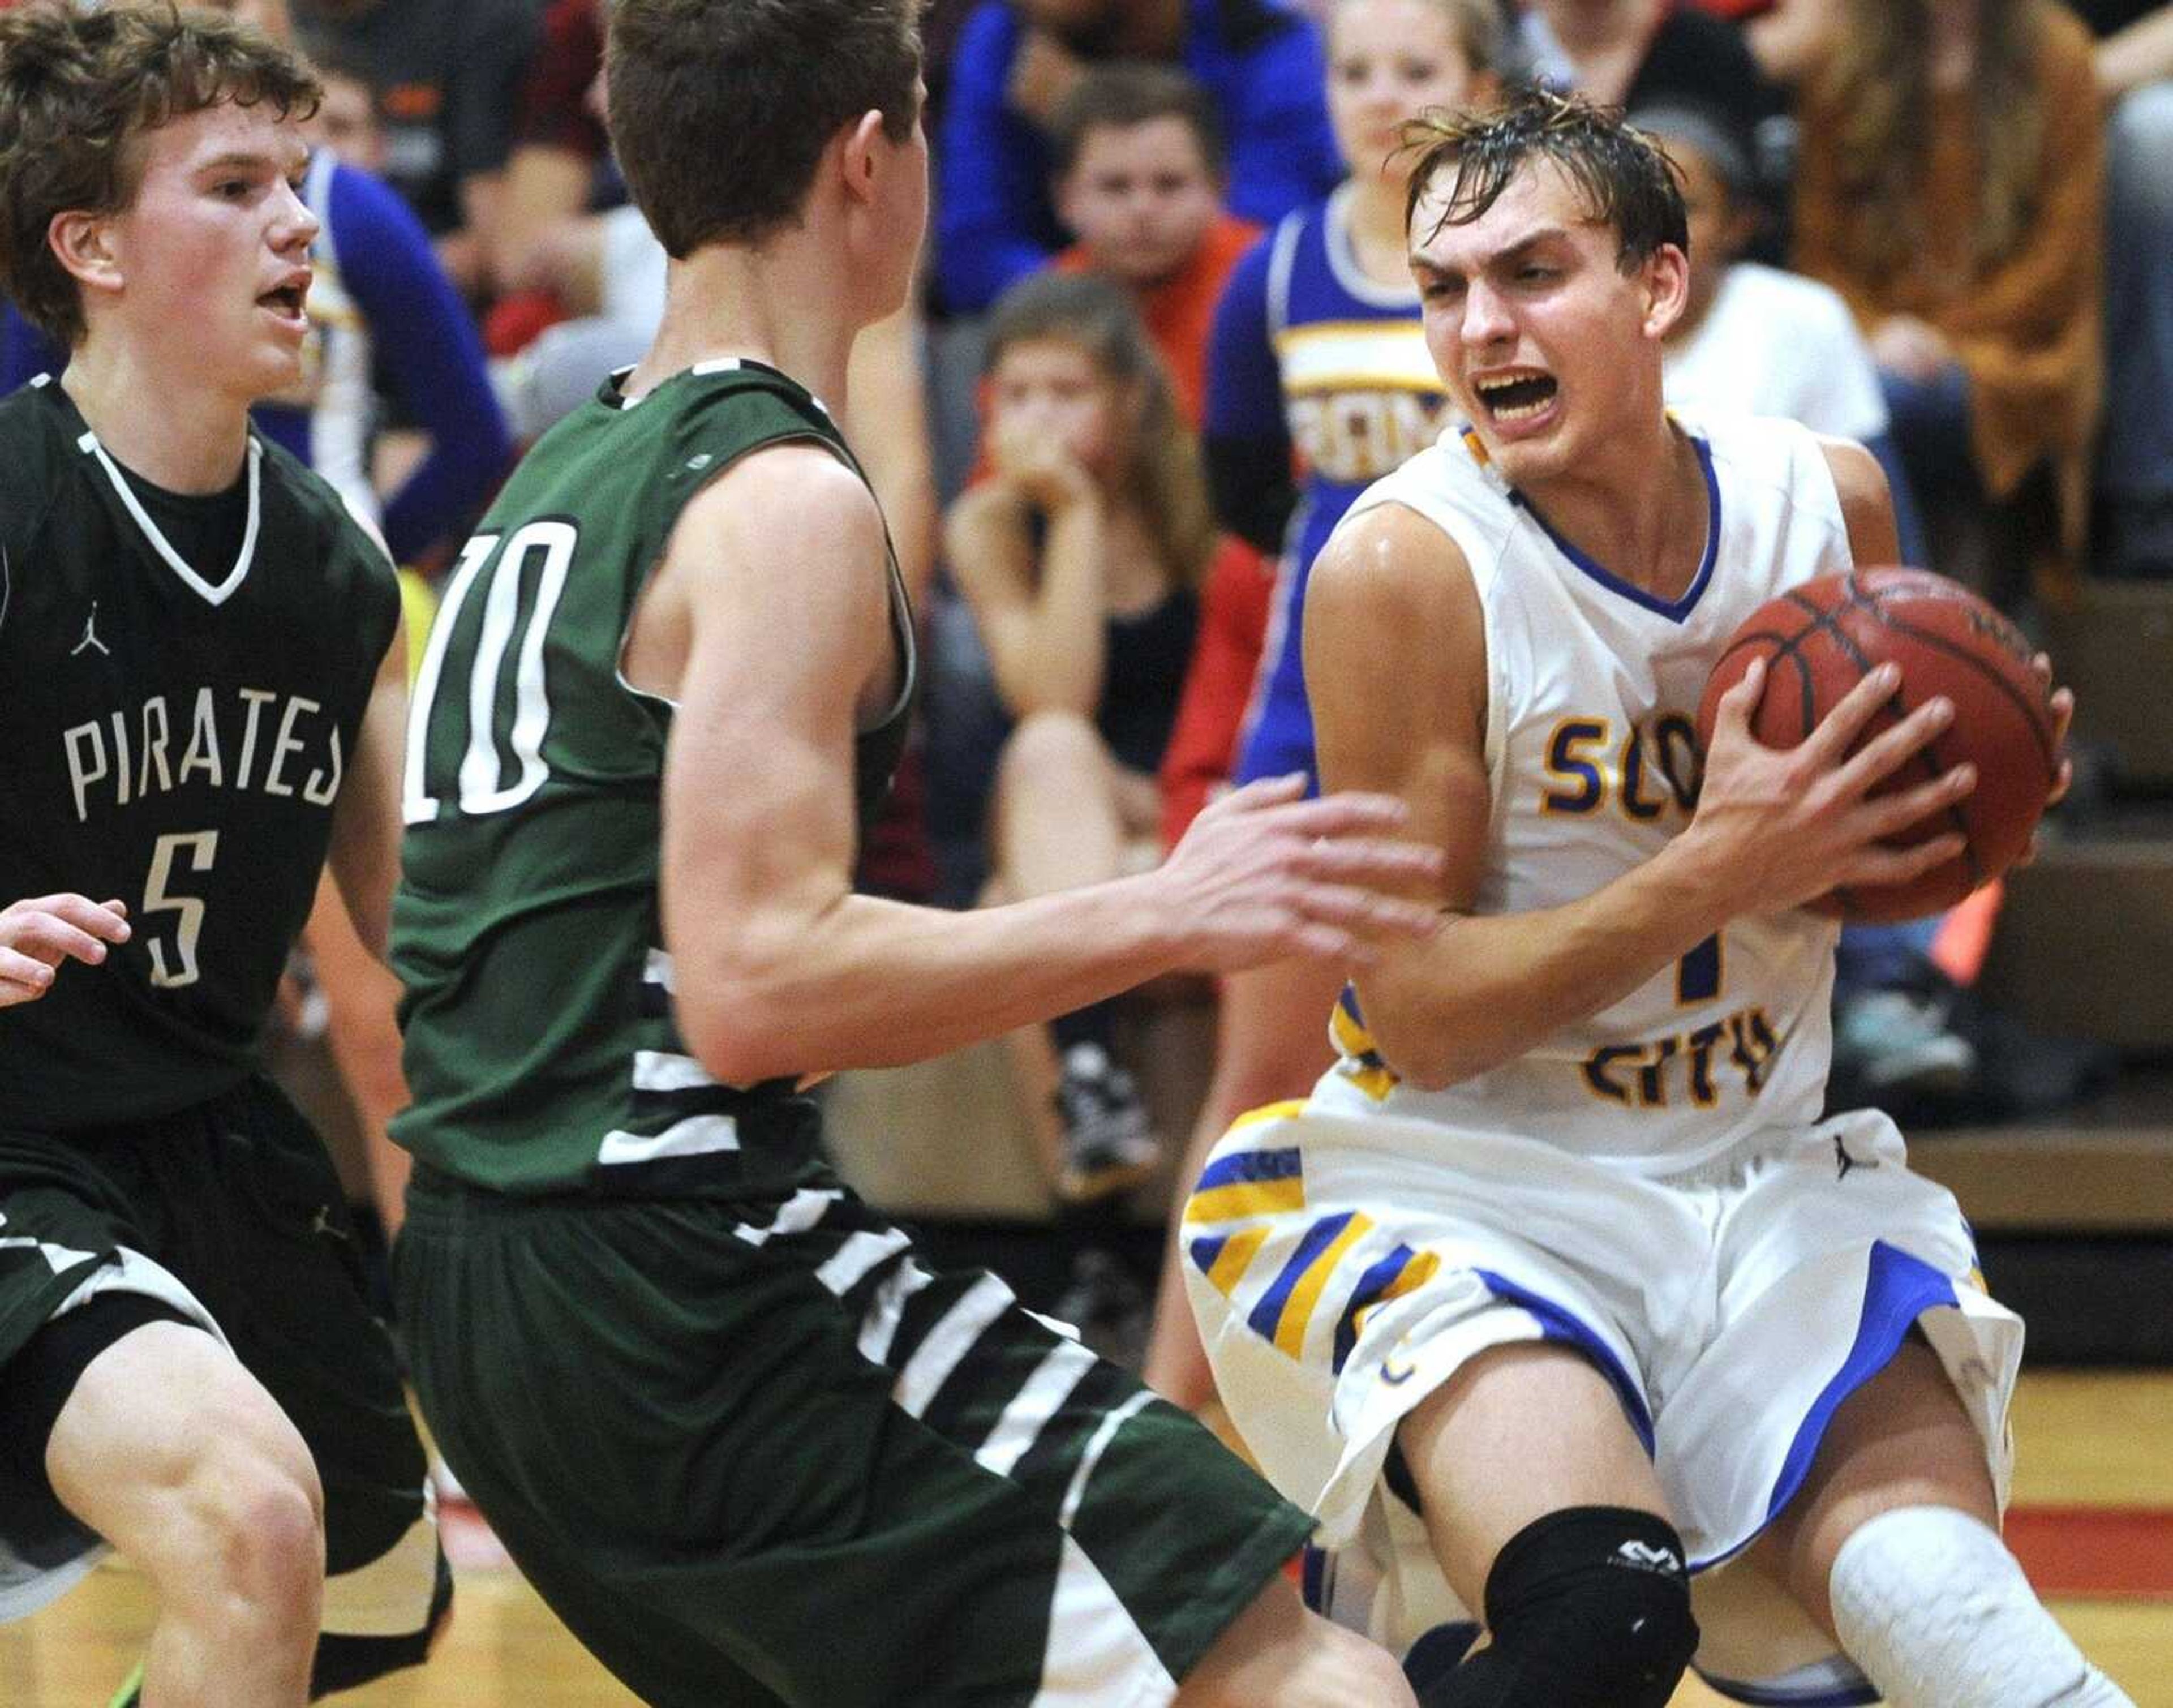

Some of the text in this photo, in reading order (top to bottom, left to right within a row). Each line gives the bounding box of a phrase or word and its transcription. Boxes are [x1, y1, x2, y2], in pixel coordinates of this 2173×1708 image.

[402, 520, 577, 825] 10
[1538, 712, 1706, 823] SCO
[142, 830, 219, 989] 5
[1579, 1004, 1783, 1109] CITY
